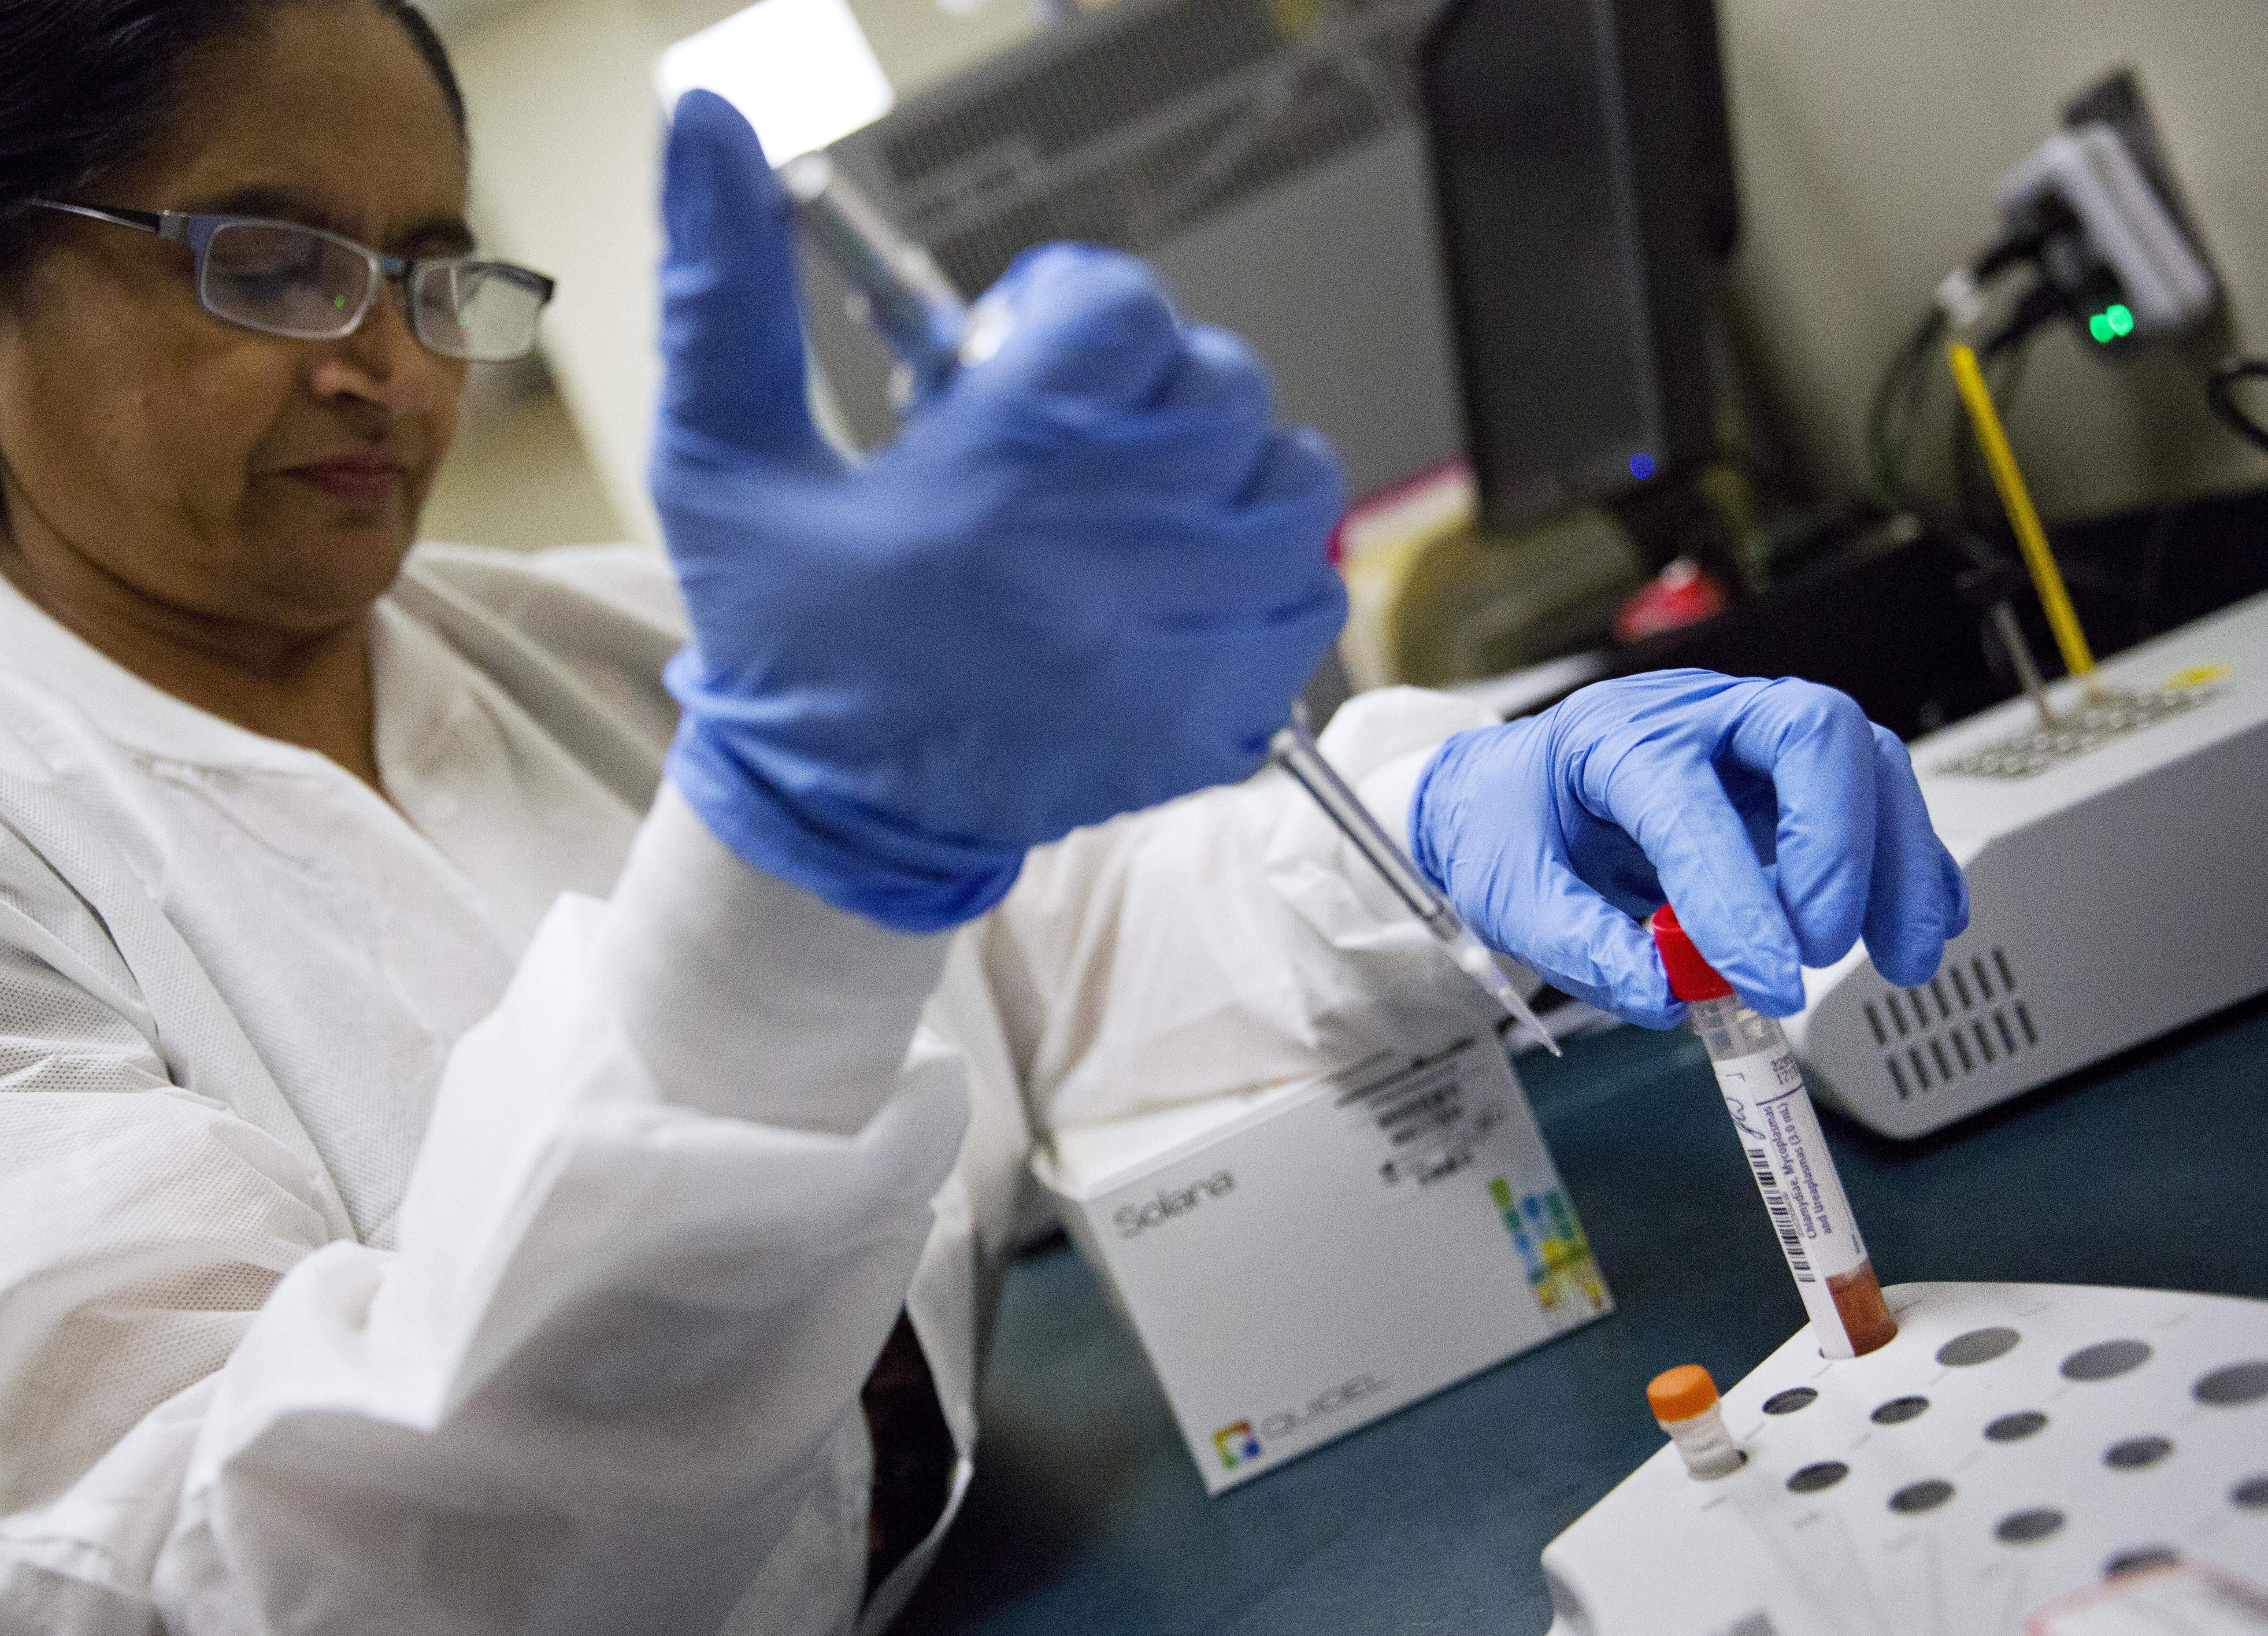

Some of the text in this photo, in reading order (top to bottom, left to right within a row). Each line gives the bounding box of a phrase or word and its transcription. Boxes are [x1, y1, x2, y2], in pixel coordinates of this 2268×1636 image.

[1778, 1102, 1792, 1122] mL)
[1764, 1106, 1794, 1175] Mycoplasmas
[1786, 1125, 1801, 1145] (3.0
[1795, 1147, 1823, 1213] Ureaplasmas
[1791, 1177, 1816, 1238] Chlamydiae,
[1817, 1214, 1831, 1234] and
